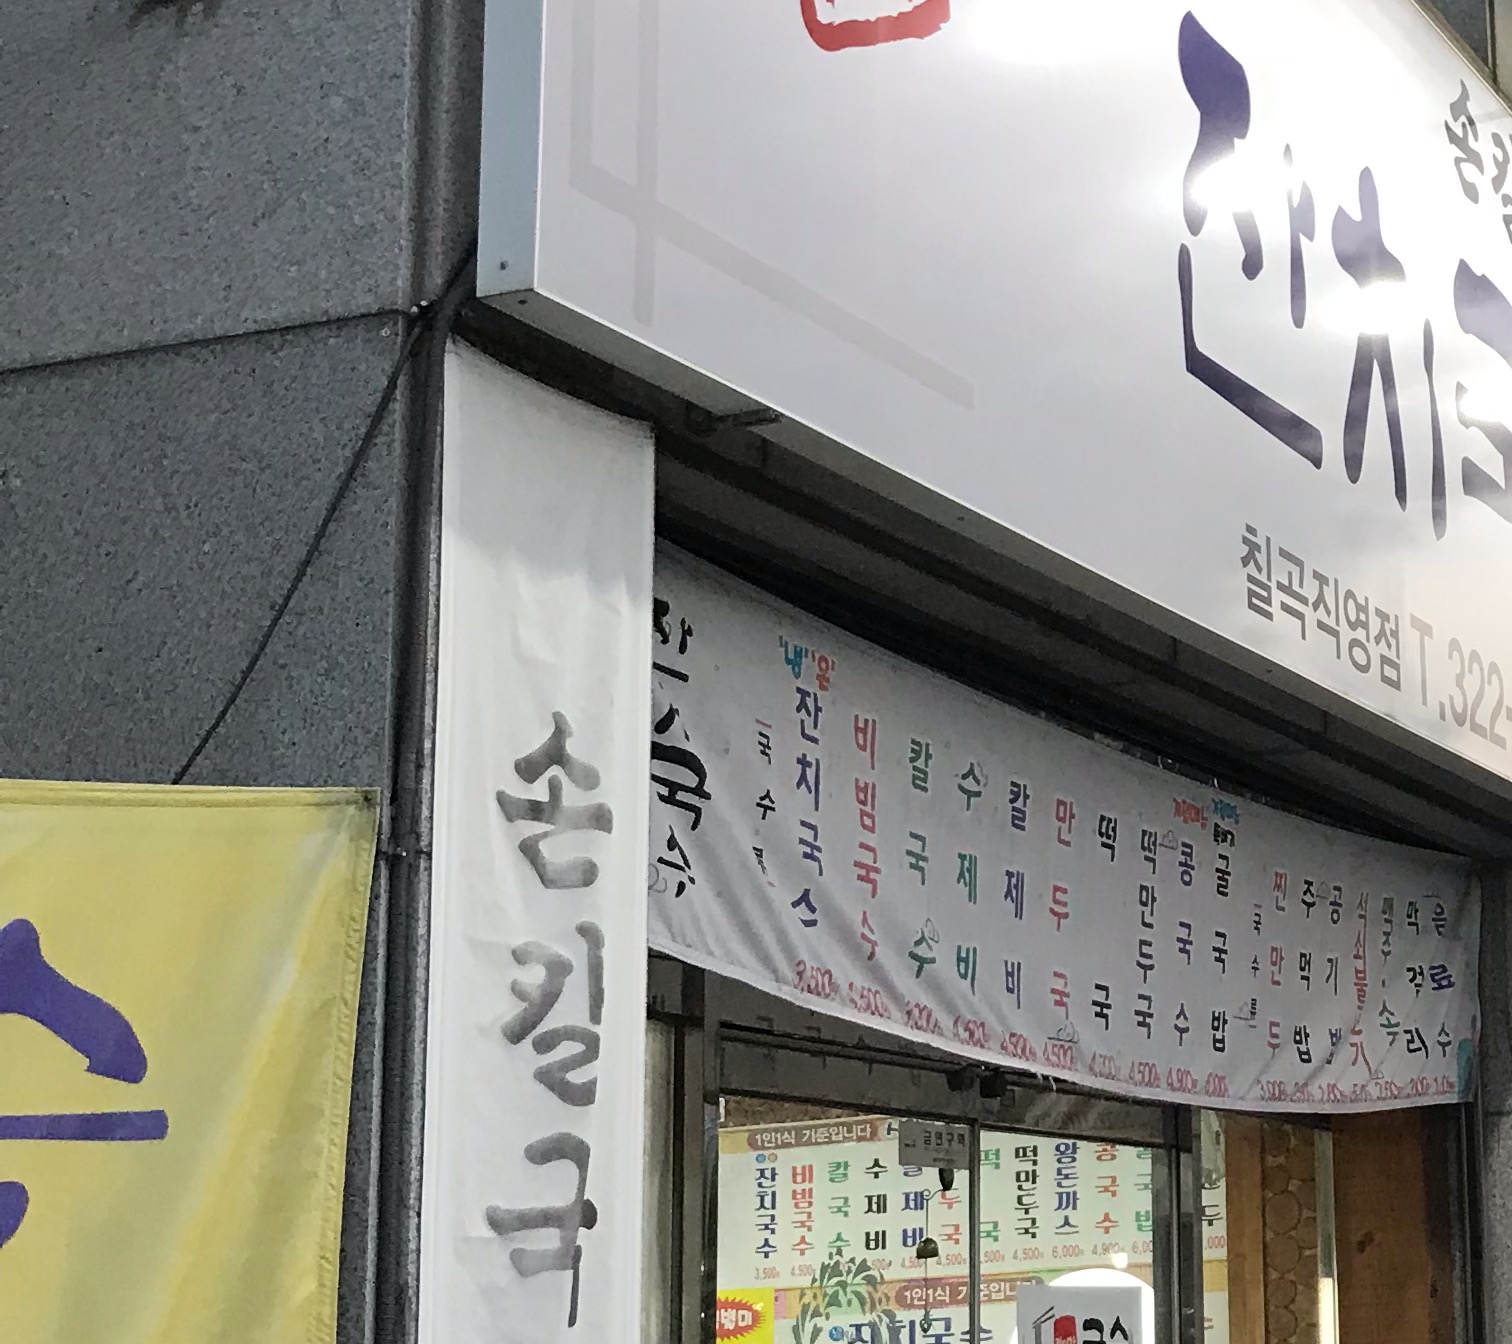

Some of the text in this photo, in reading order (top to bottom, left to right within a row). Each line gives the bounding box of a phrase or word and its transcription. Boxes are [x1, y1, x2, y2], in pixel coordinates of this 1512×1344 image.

[1240, 522, 1401, 692] 칠곡직영점
[853, 714, 882, 961] 비빔국수
[906, 737, 936, 980] 칼국수
[956, 761, 984, 996] 수제비
[1003, 779, 1031, 1010] 칼제비
[1048, 796, 1076, 1020] 만두국
[1091, 813, 1119, 1031] 떡국
[1133, 828, 1160, 1040] 떡만두국
[1173, 841, 1196, 1047] 콩국수
[1293, 878, 1318, 1064] 주먹밥
[1403, 901, 1429, 1060] 막걸리
[754, 1166, 779, 1259] 잔치국수
[755, 1131, 796, 1147] 1인1식
[802, 1123, 872, 1143] 기준입니다
[791, 1164, 815, 1257] 비빔국수
[828, 1159, 851, 1254] 칼국수
[864, 1157, 889, 1251] 수제비
[980, 1147, 1001, 1243] 떡국
[1014, 1144, 1040, 1239] 떡만두국
[1054, 1141, 1080, 1236] 왕돈까스
